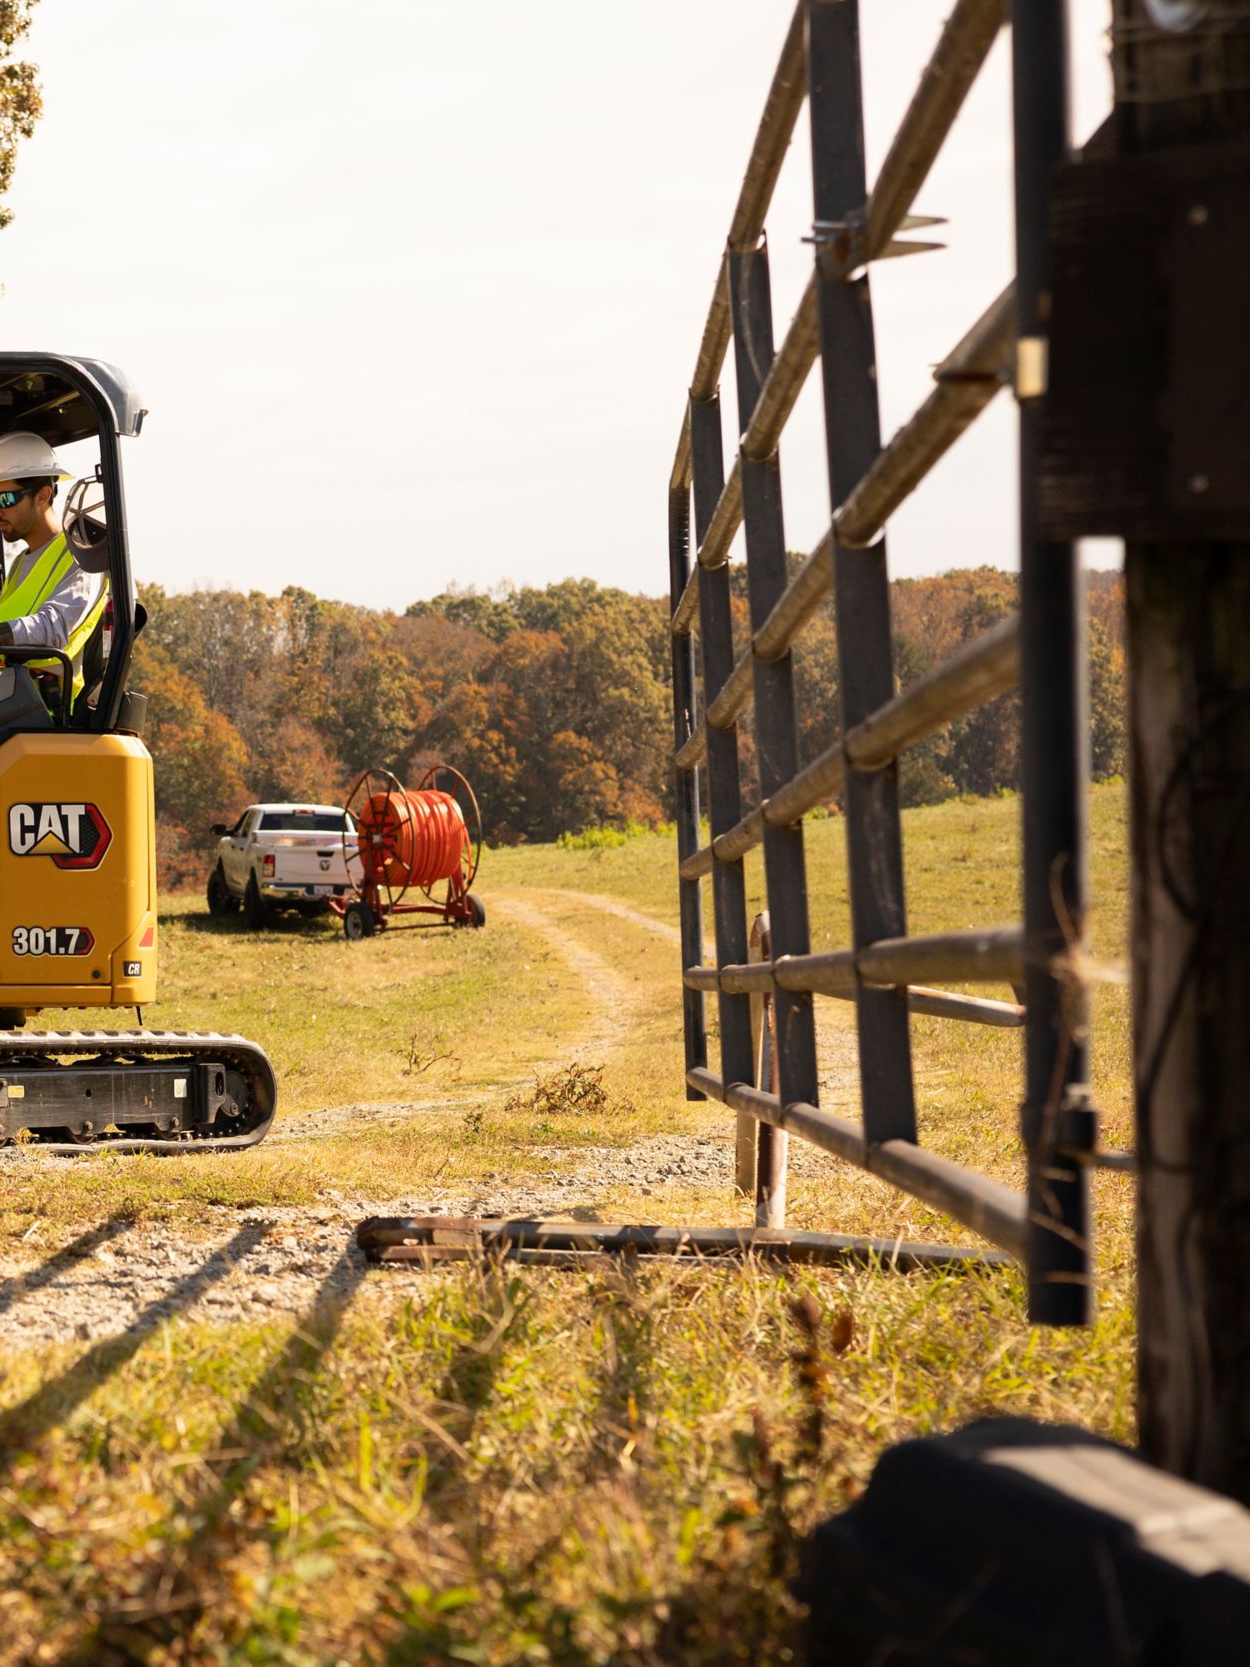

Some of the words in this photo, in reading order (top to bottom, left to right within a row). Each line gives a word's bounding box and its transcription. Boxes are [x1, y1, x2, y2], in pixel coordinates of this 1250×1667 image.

[9, 804, 86, 854] CAT
[13, 927, 80, 954] 301.7
[127, 963, 140, 975] CR
